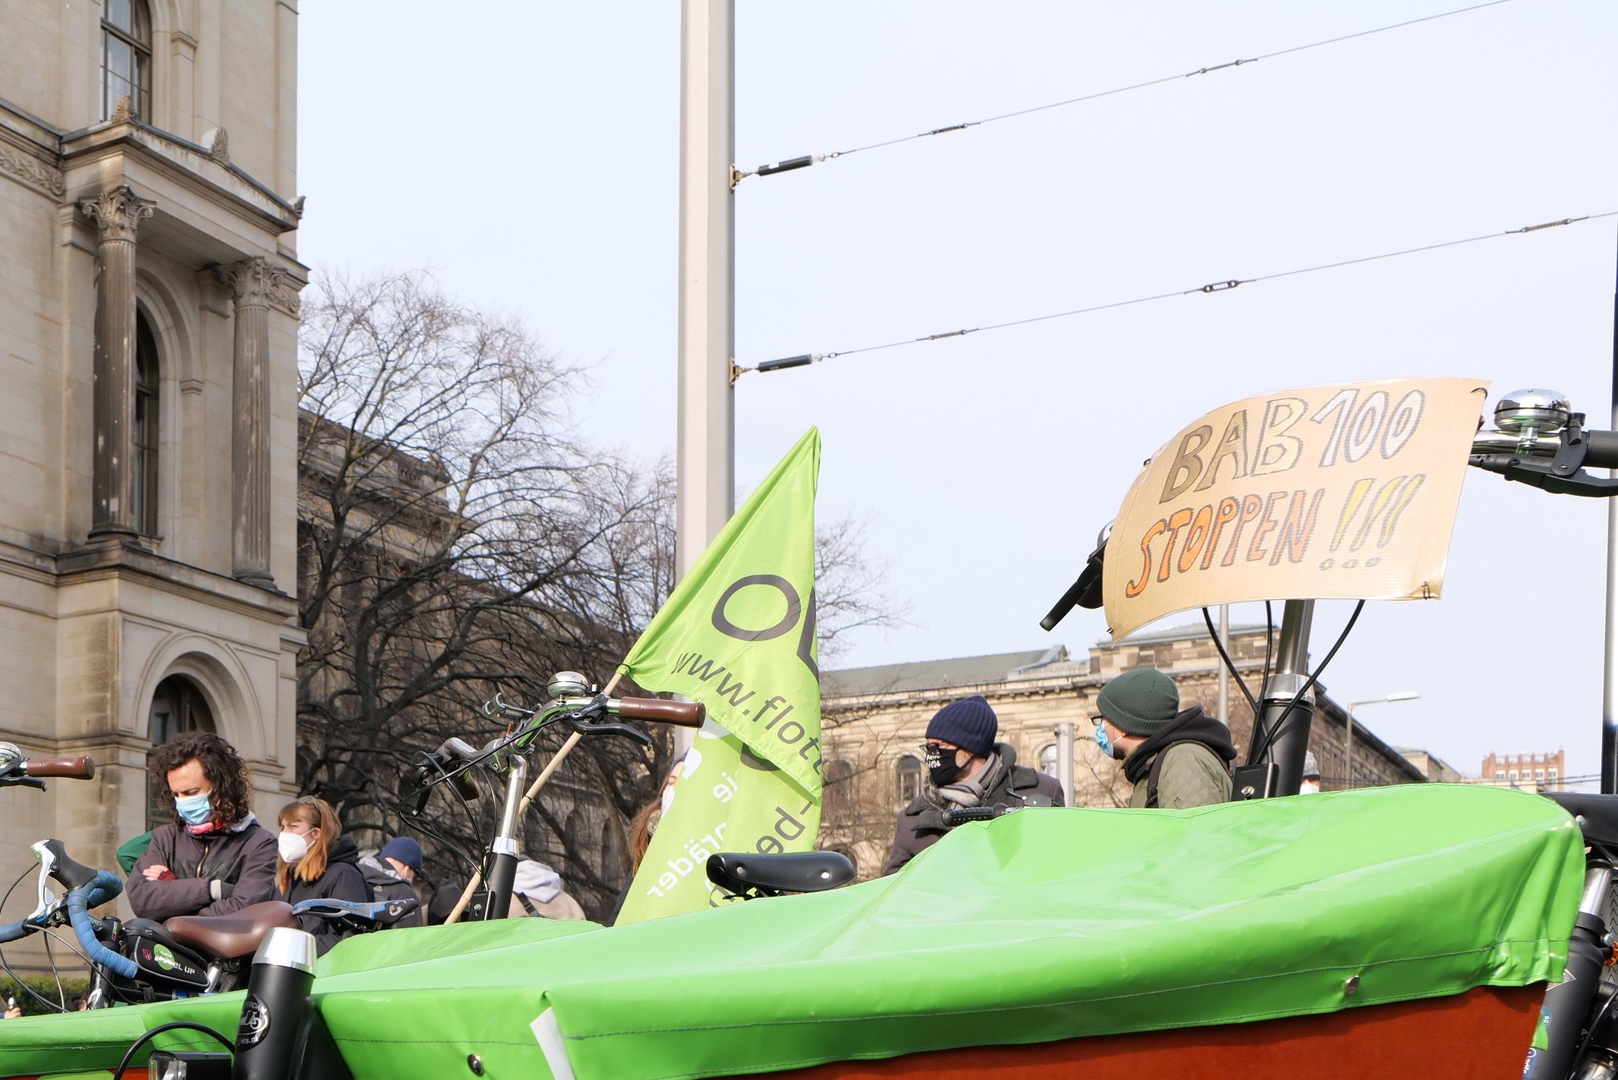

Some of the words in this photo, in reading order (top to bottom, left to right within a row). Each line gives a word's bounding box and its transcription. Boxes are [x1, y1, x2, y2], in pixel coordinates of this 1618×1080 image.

[1159, 396, 1308, 505] BAB
[1311, 387, 1426, 468] 100
[1125, 487, 1325, 599] STOPPEN
